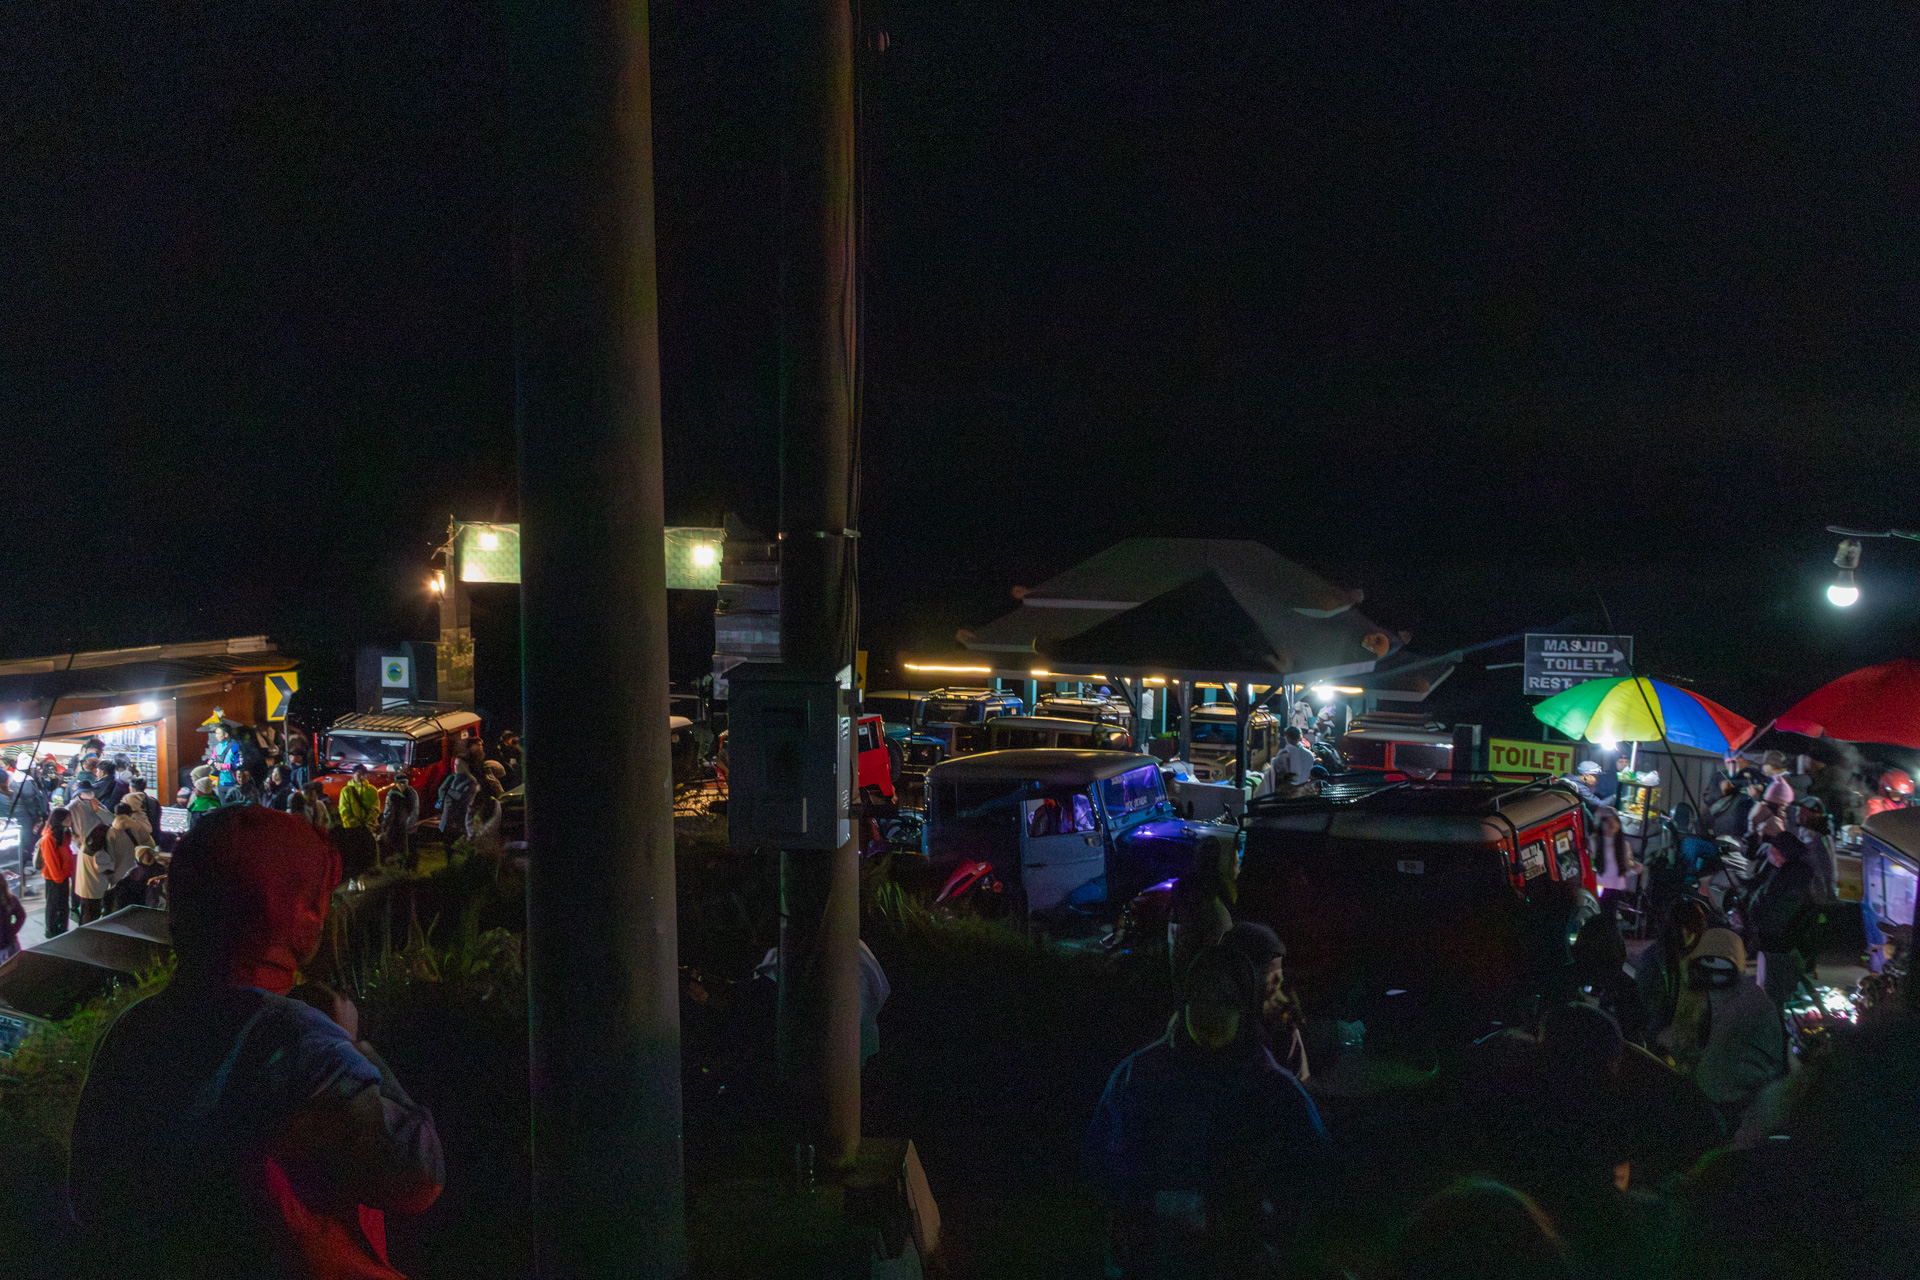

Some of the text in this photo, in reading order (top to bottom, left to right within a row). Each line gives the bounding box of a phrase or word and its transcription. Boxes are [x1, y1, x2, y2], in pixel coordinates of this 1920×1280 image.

[1544, 639, 1608, 652] MASJID
[1543, 658, 1606, 671] TOILET
[1492, 745, 1570, 771] TOILET
